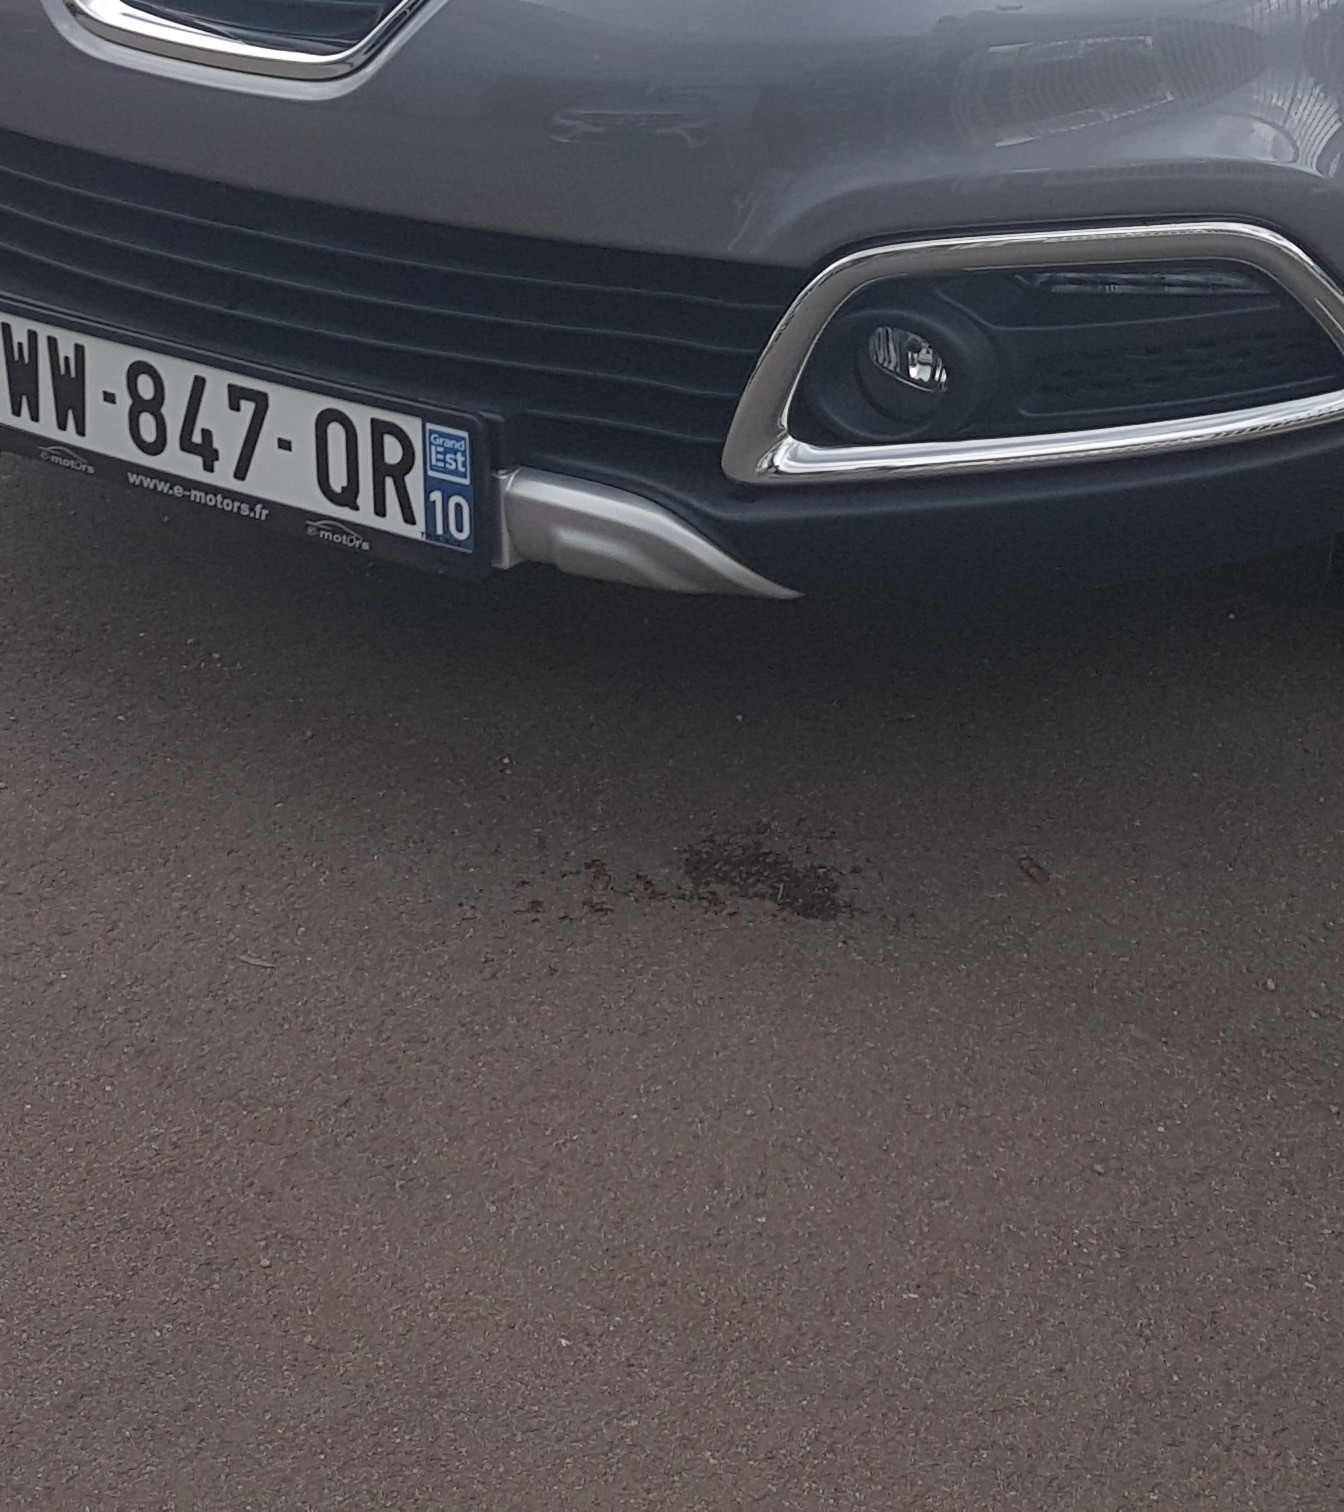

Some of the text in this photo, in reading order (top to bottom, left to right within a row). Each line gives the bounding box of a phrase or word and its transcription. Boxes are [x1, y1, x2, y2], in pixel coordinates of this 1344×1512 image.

[0, 321, 417, 526] WW-847-QR
[429, 433, 466, 451] Grand
[431, 445, 467, 473] Est
[126, 471, 270, 522] www.e-motors.fr
[429, 489, 471, 541] 10
